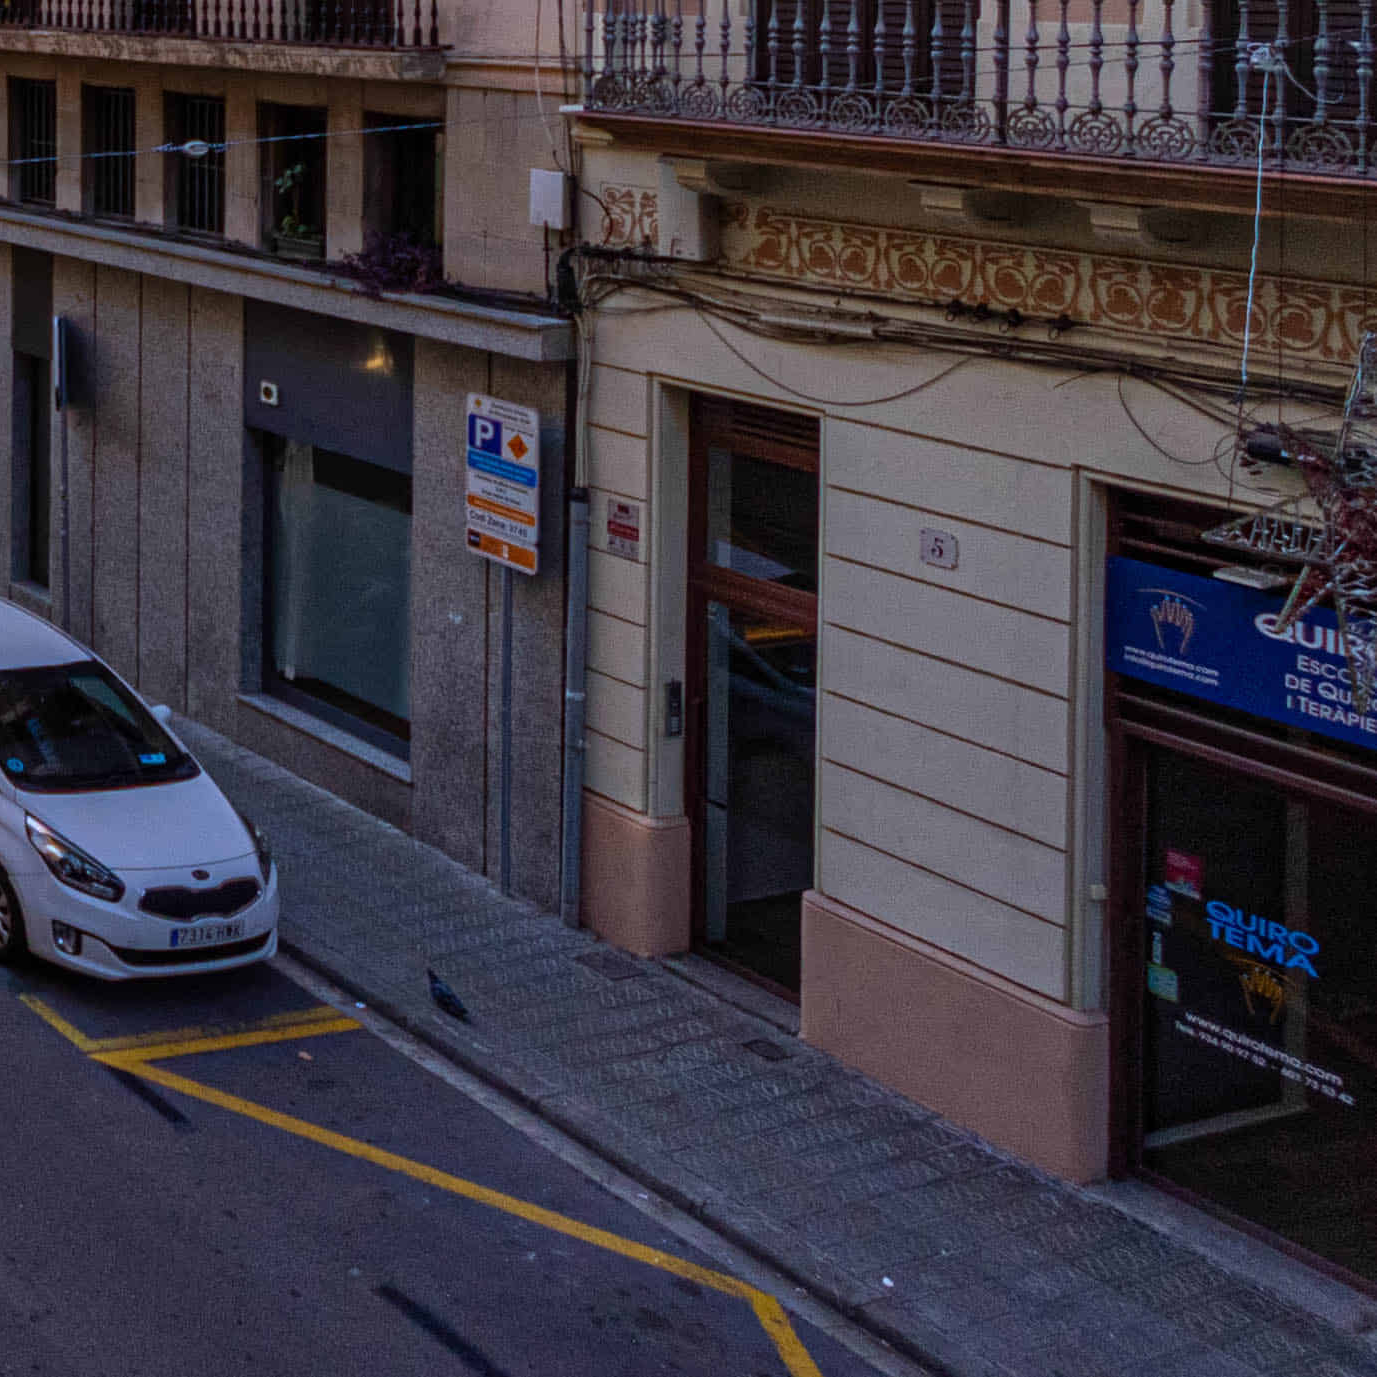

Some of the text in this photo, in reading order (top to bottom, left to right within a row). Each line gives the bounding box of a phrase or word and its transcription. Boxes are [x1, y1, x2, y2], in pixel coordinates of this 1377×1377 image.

[475, 417, 494, 448] P
[931, 537, 944, 559] 5
[1284, 673, 1312, 694] DE
[1286, 694, 1293, 709] I
[1206, 899, 1320, 956] QUIRO
[1206, 916, 1320, 979] TEMA
